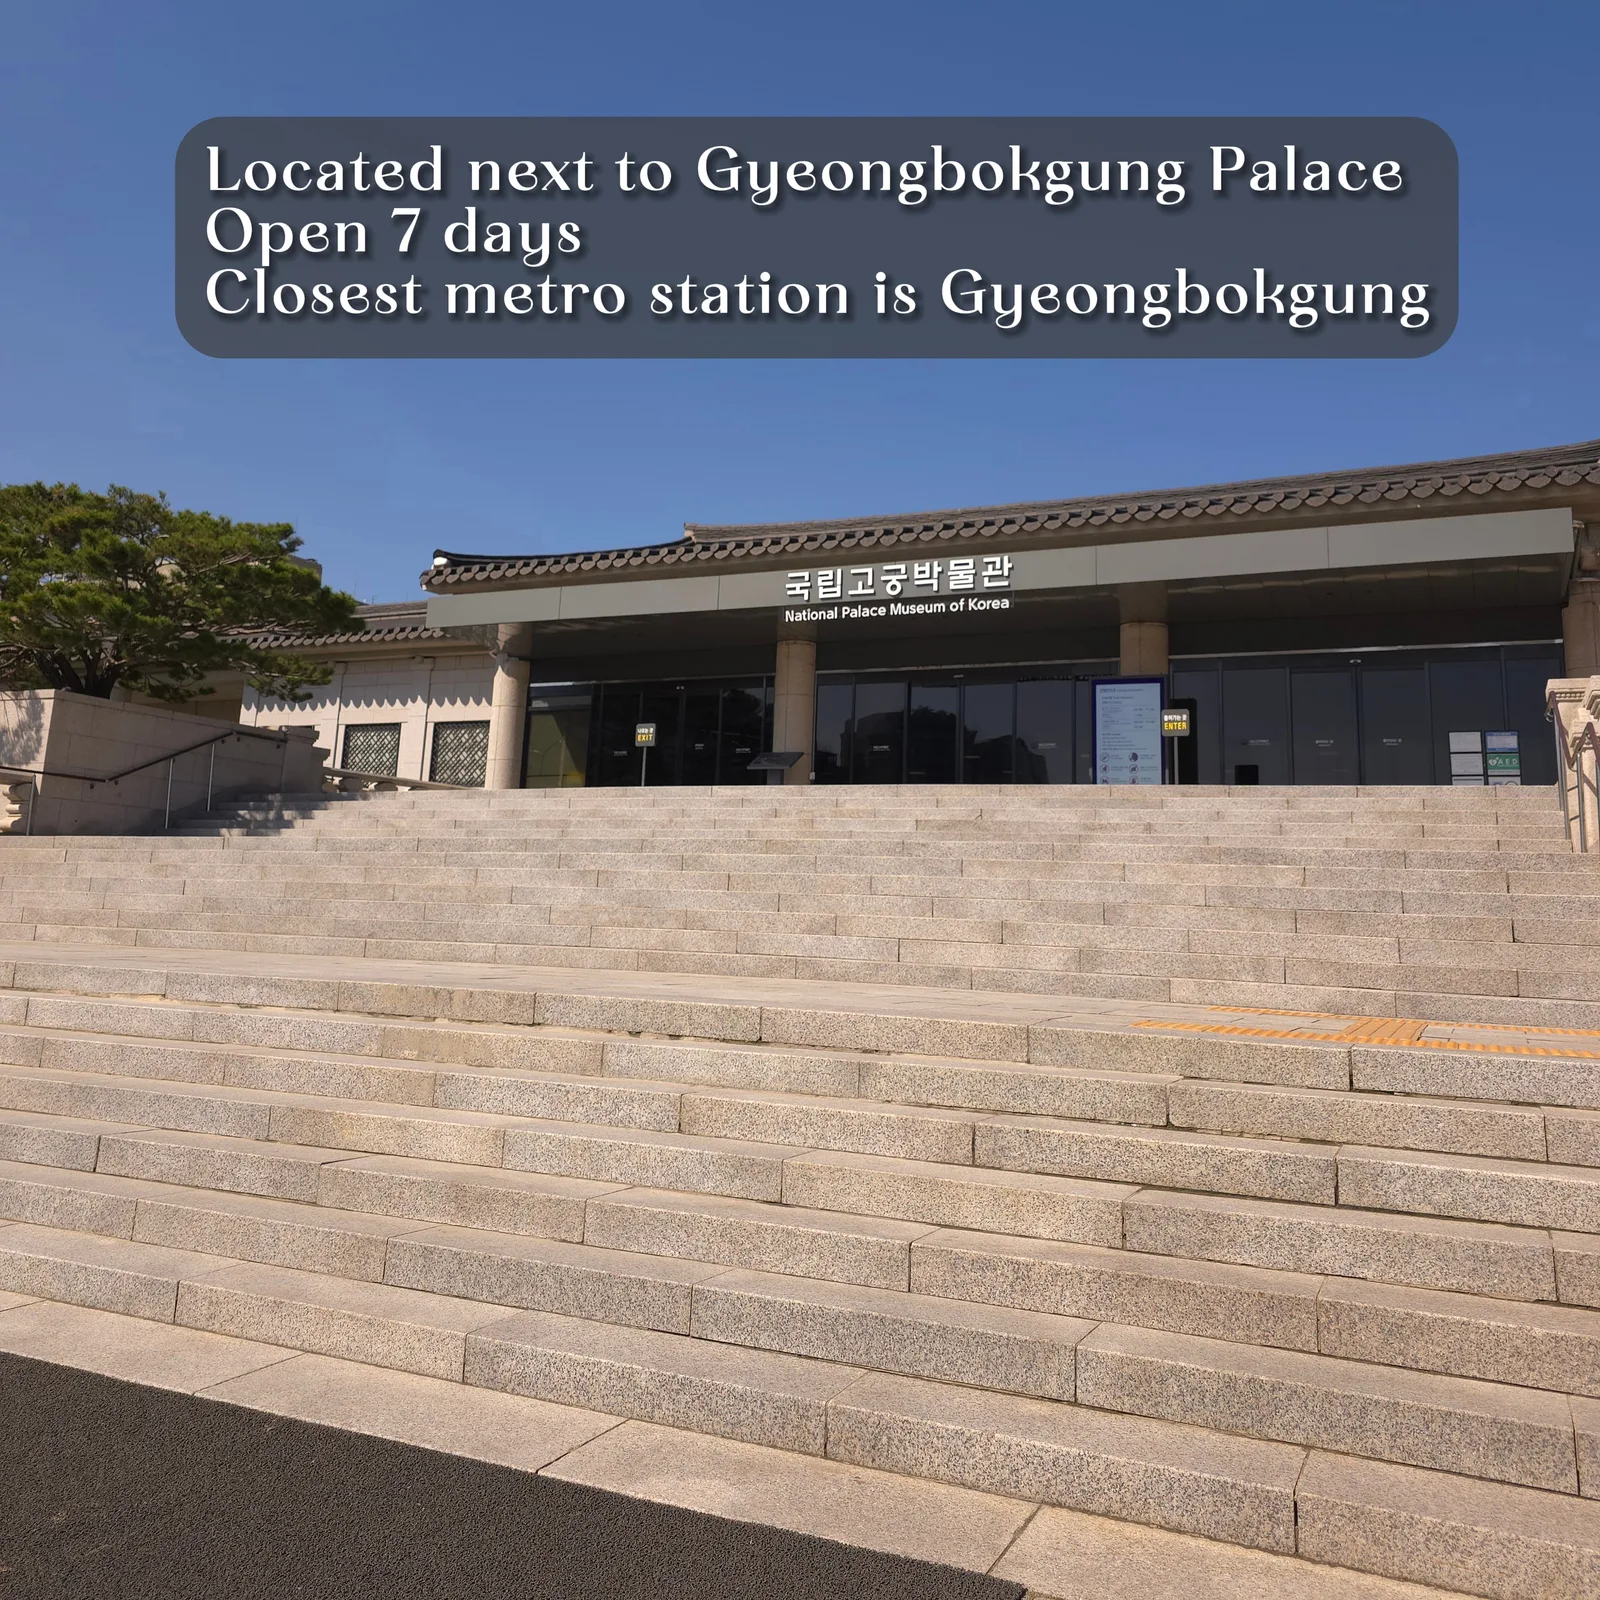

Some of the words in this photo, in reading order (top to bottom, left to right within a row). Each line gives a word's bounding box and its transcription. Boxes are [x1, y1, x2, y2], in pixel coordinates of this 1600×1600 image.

[785, 555, 1013, 601] 국립고궁박물관
[785, 606, 838, 622] National
[842, 604, 887, 619] Palace
[890, 602, 946, 616] Museum
[950, 598, 966, 611] of
[968, 597, 1010, 611] Korea
[1164, 722, 1187, 730] ENTER
